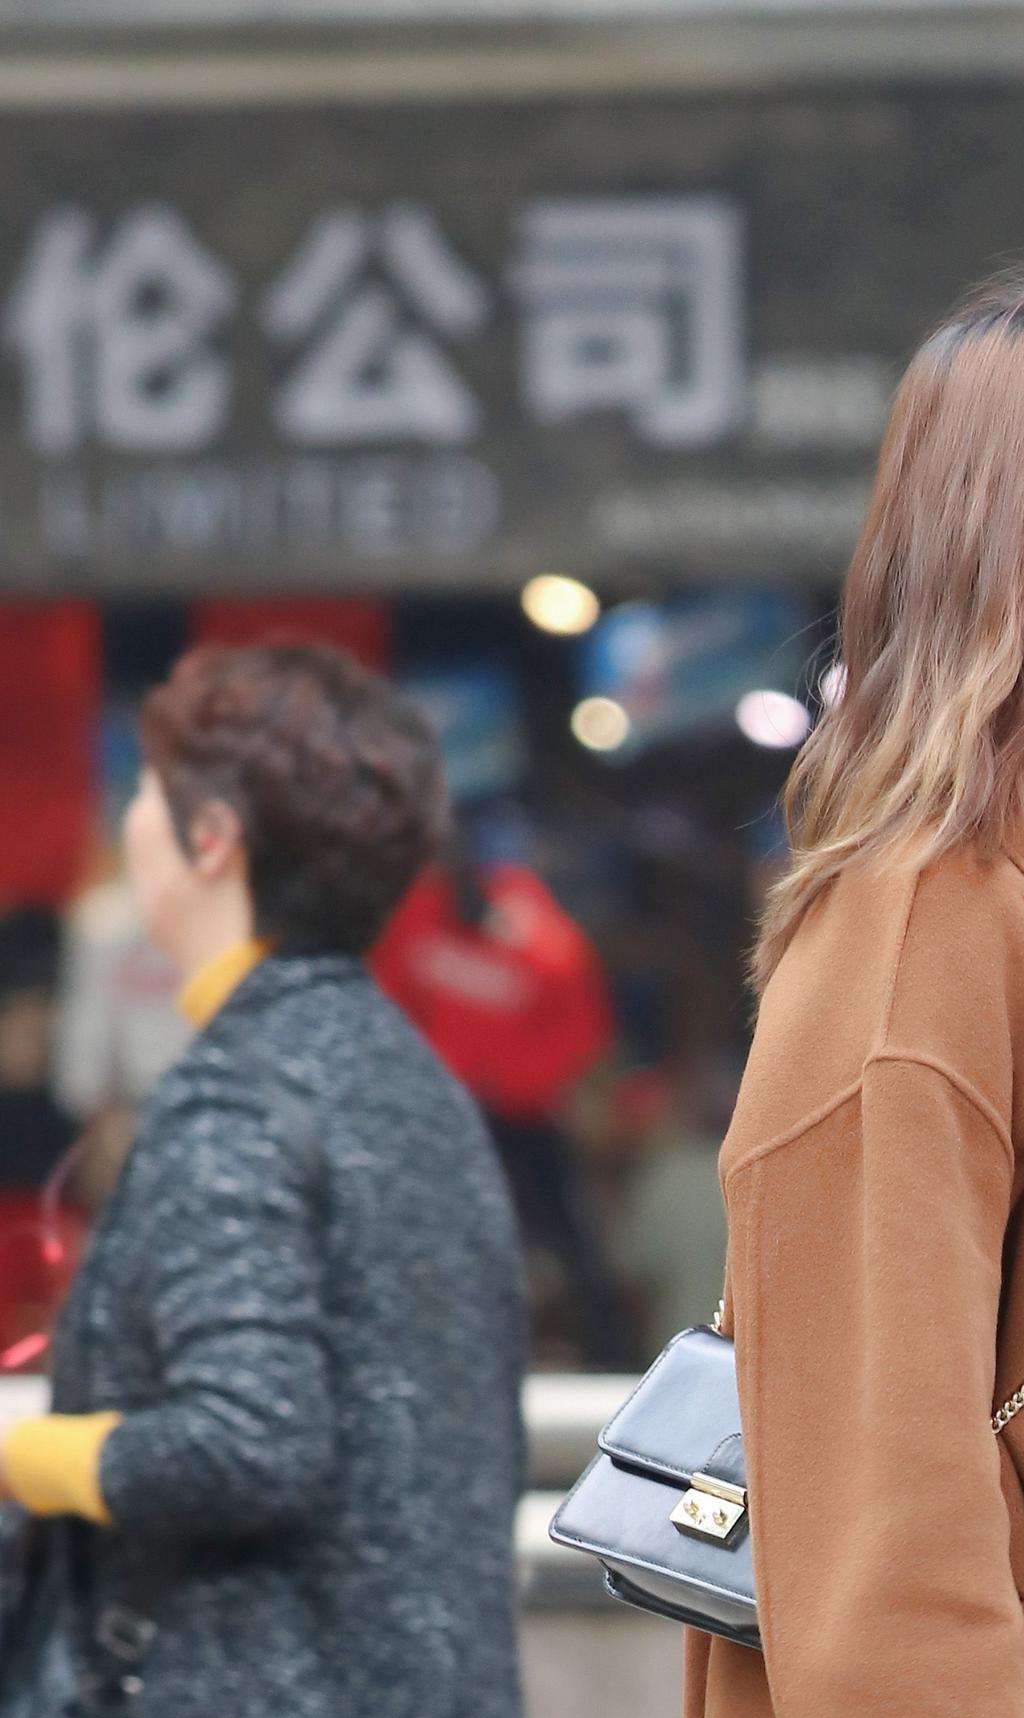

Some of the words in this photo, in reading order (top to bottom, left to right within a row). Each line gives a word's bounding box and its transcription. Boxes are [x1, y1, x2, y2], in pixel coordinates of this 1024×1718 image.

[12, 200, 744, 454] 伦公司
[42, 460, 499, 556] LIMITED
